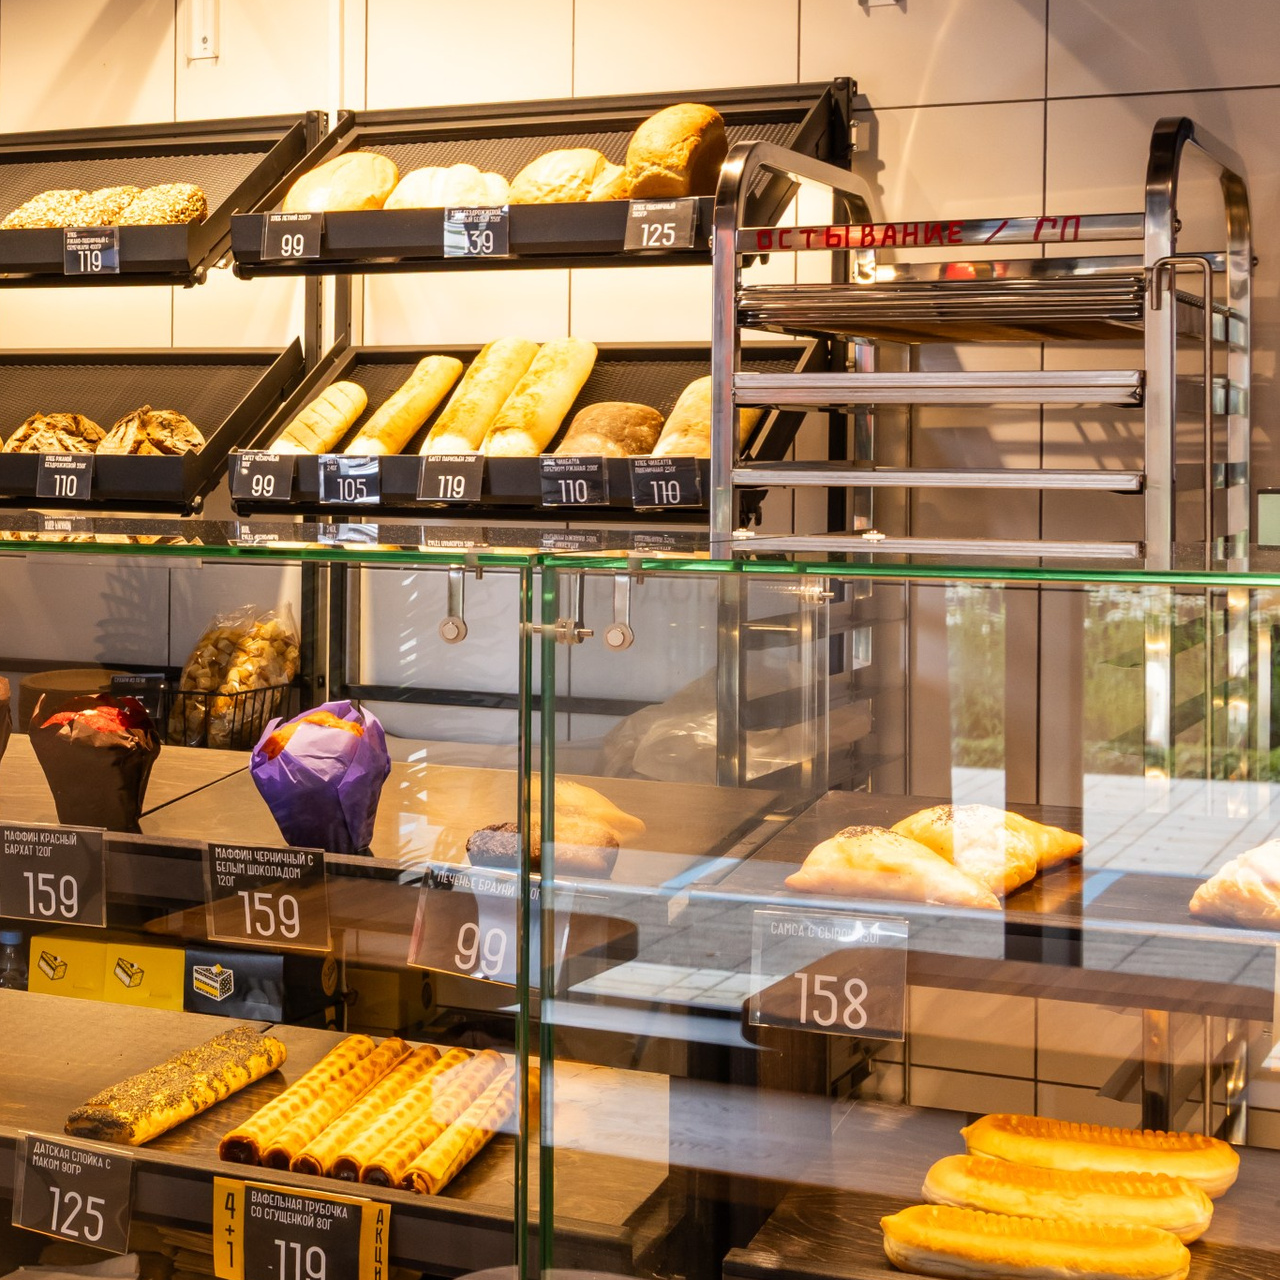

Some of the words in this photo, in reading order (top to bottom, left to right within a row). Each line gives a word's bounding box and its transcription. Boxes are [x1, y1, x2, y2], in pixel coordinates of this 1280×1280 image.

[280, 233, 304, 256] 99
[641, 222, 675, 246] 125
[756, 219, 964, 252] ОСТЫВАНИЕ
[78, 250, 102, 272] 119
[438, 475, 465, 499] 119
[4, 830, 38, 843] МАФФИН
[40, 832, 77, 845] КРАСНЫЙ
[4, 843, 34, 856] БАРХАТ
[36, 846, 53, 857] 120Г
[23, 872, 78, 918] 159
[237, 890, 300, 938] 159
[454, 922, 507, 976] 99
[794, 973, 868, 1029] 158
[49, 1186, 105, 1242] 125
[251, 1206, 262, 1217] СО
[264, 1207, 314, 1226] СГУЩЕНКОЙ
[316, 1218, 332, 1230] 80Г
[252, 1191, 303, 1209] ВАФЕЛЬНАЯ
[305, 1202, 348, 1219] ТРУБОЧКА
